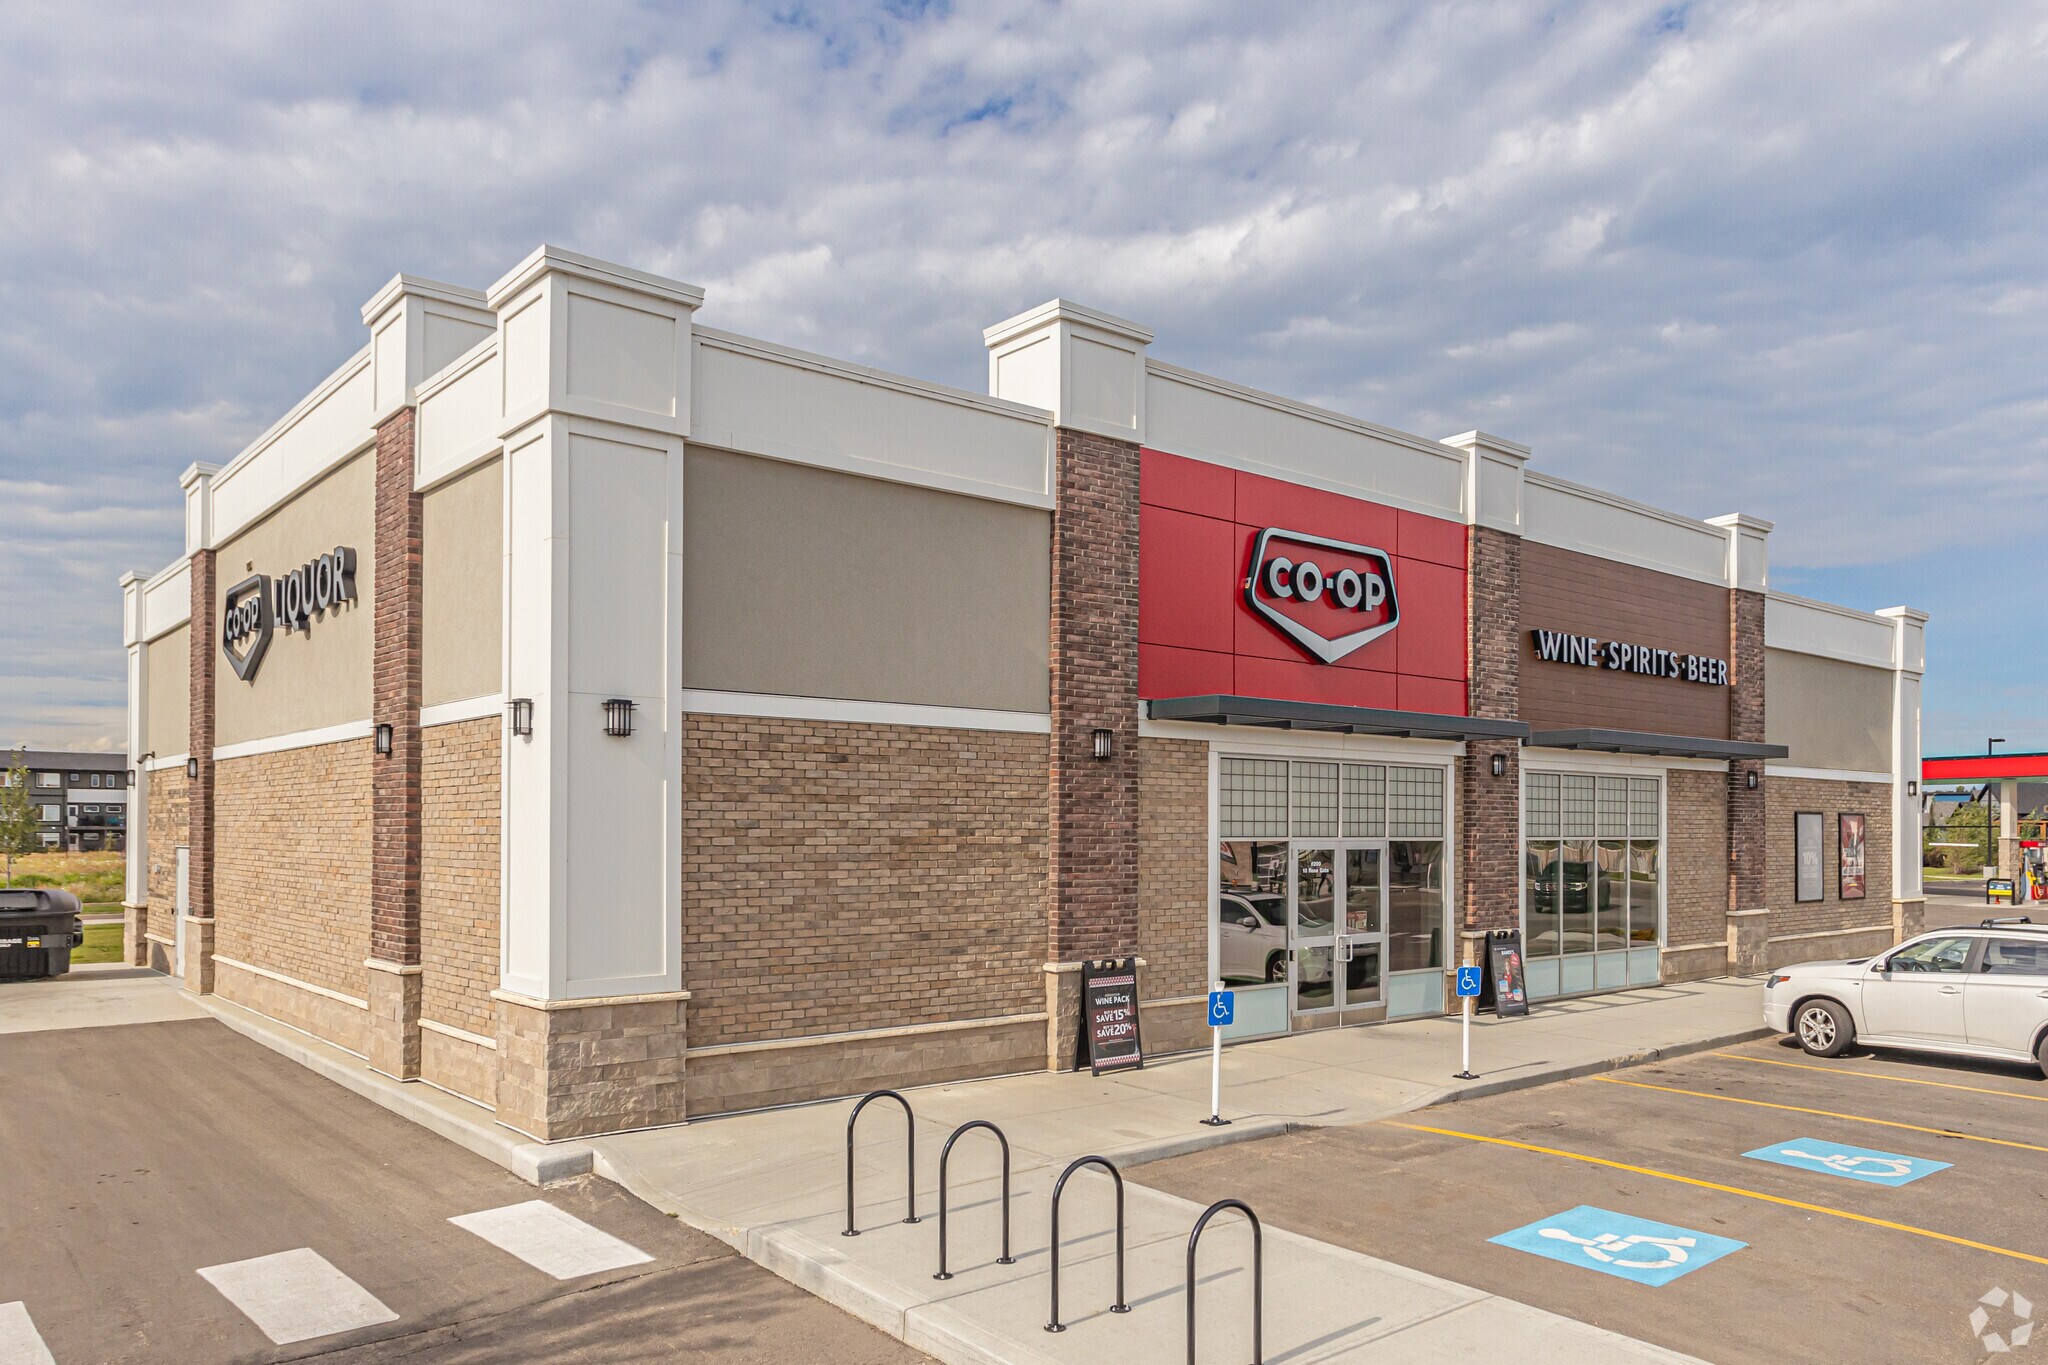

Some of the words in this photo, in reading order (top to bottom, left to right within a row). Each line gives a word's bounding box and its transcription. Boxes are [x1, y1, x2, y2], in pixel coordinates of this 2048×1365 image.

[273, 546, 353, 633] LIQUOR
[1264, 556, 1386, 612] CO-OP
[1535, 629, 1598, 667] WINE
[1606, 641, 1680, 679] SPIRITS
[1686, 654, 1728, 685] BEER
[1095, 996, 1113, 1006] WINE
[1114, 995, 1130, 1004] PACK
[1096, 1014, 1114, 1022] SAVE
[1114, 1009, 1131, 1021] 15%
[1097, 1028, 1115, 1038] SAVE
[1114, 1023, 1132, 1036] 20%
